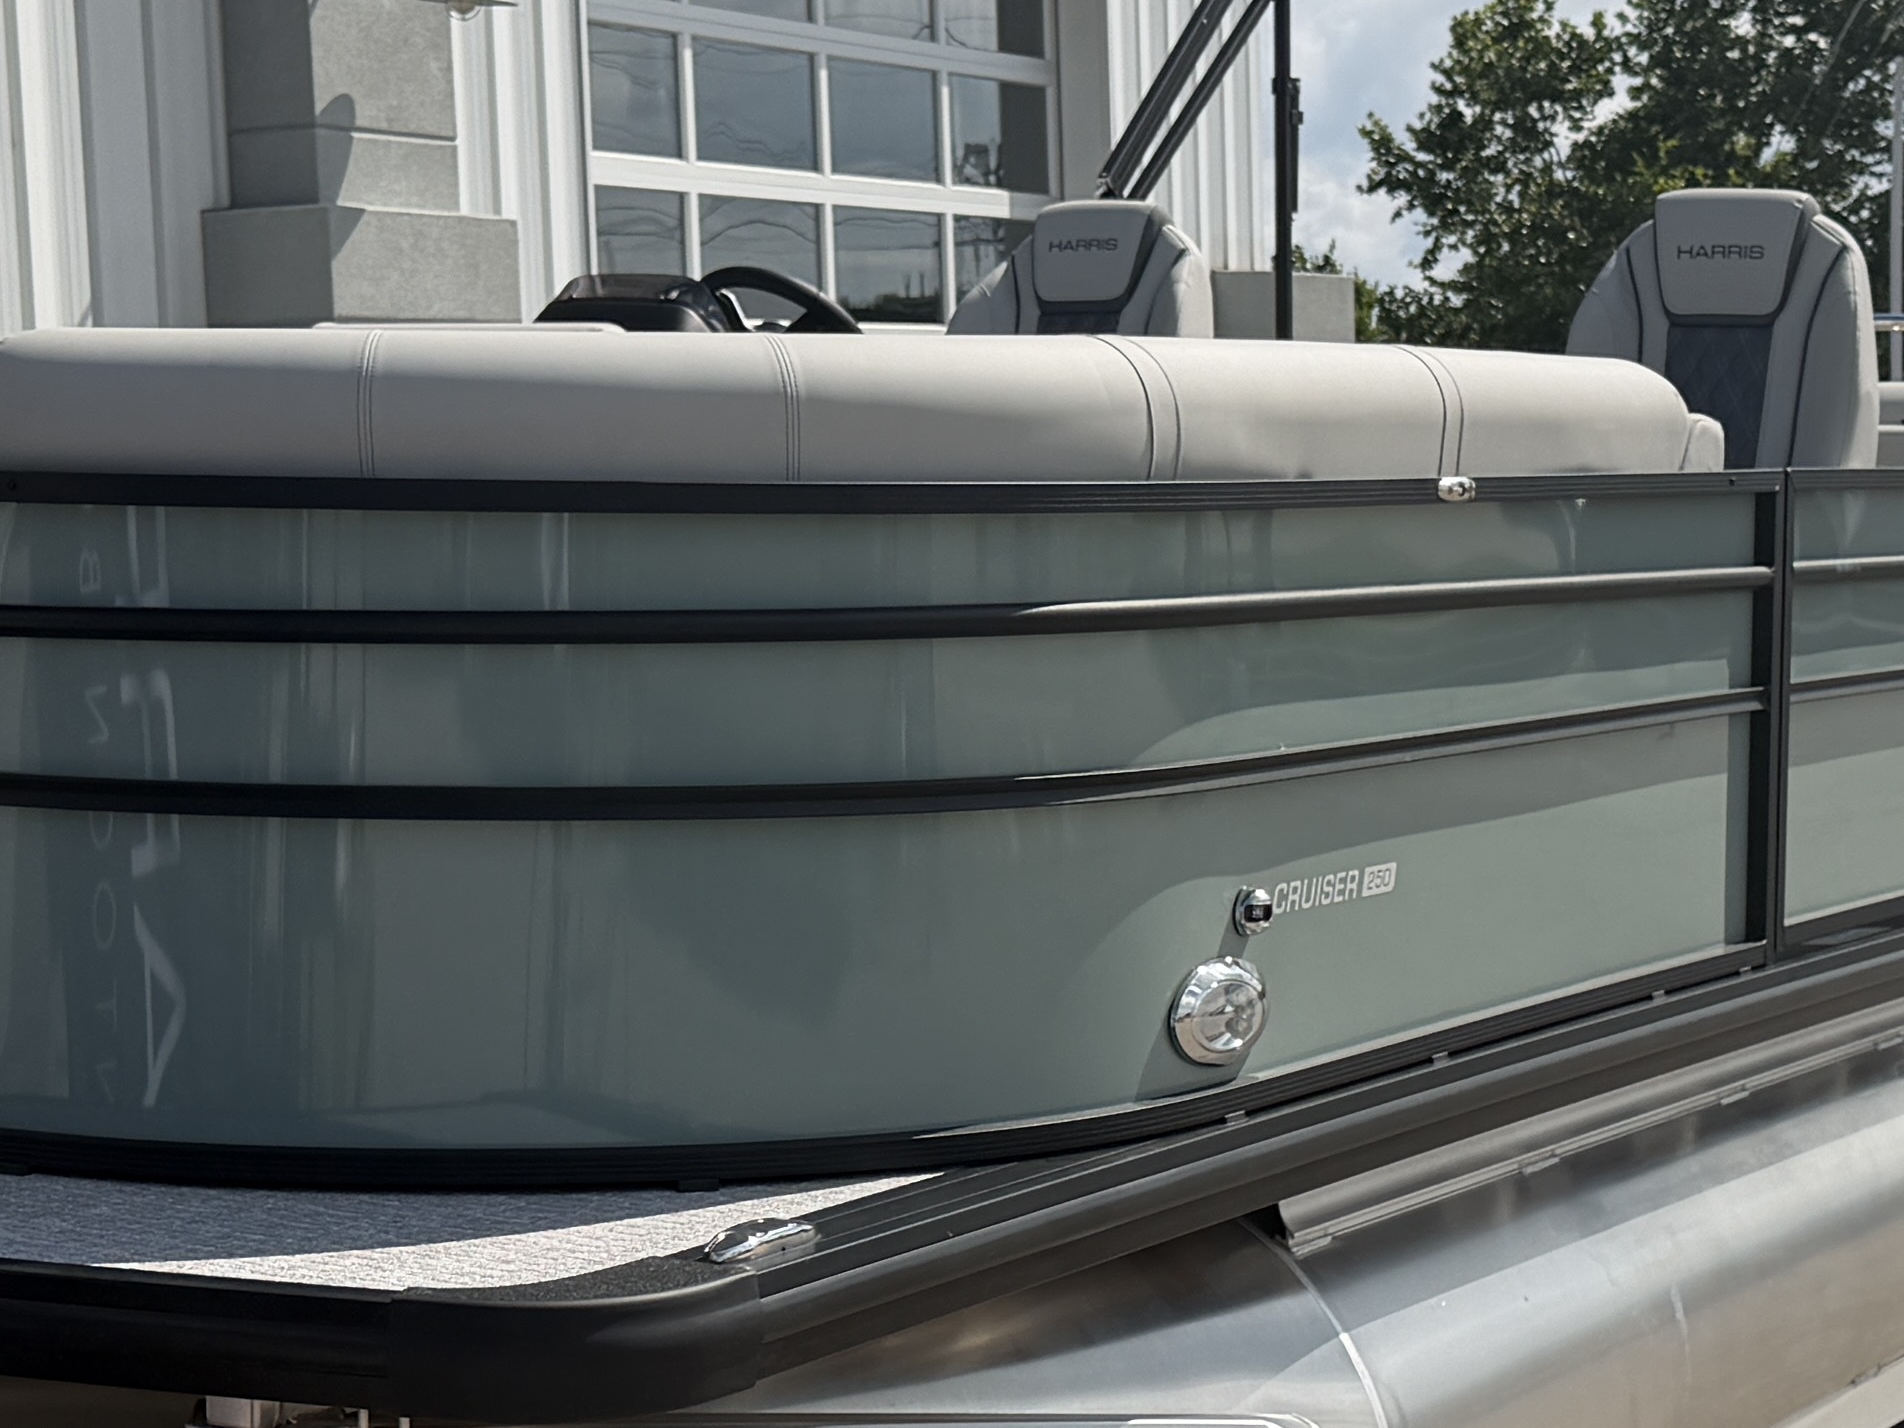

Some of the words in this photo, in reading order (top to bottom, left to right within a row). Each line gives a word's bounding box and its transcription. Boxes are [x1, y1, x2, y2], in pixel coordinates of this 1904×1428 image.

[1048, 237, 1119, 253] HARRIS
[1676, 244, 1765, 260] HARRIS
[1273, 869, 1360, 915] CRUISER
[1365, 866, 1394, 892] 250
